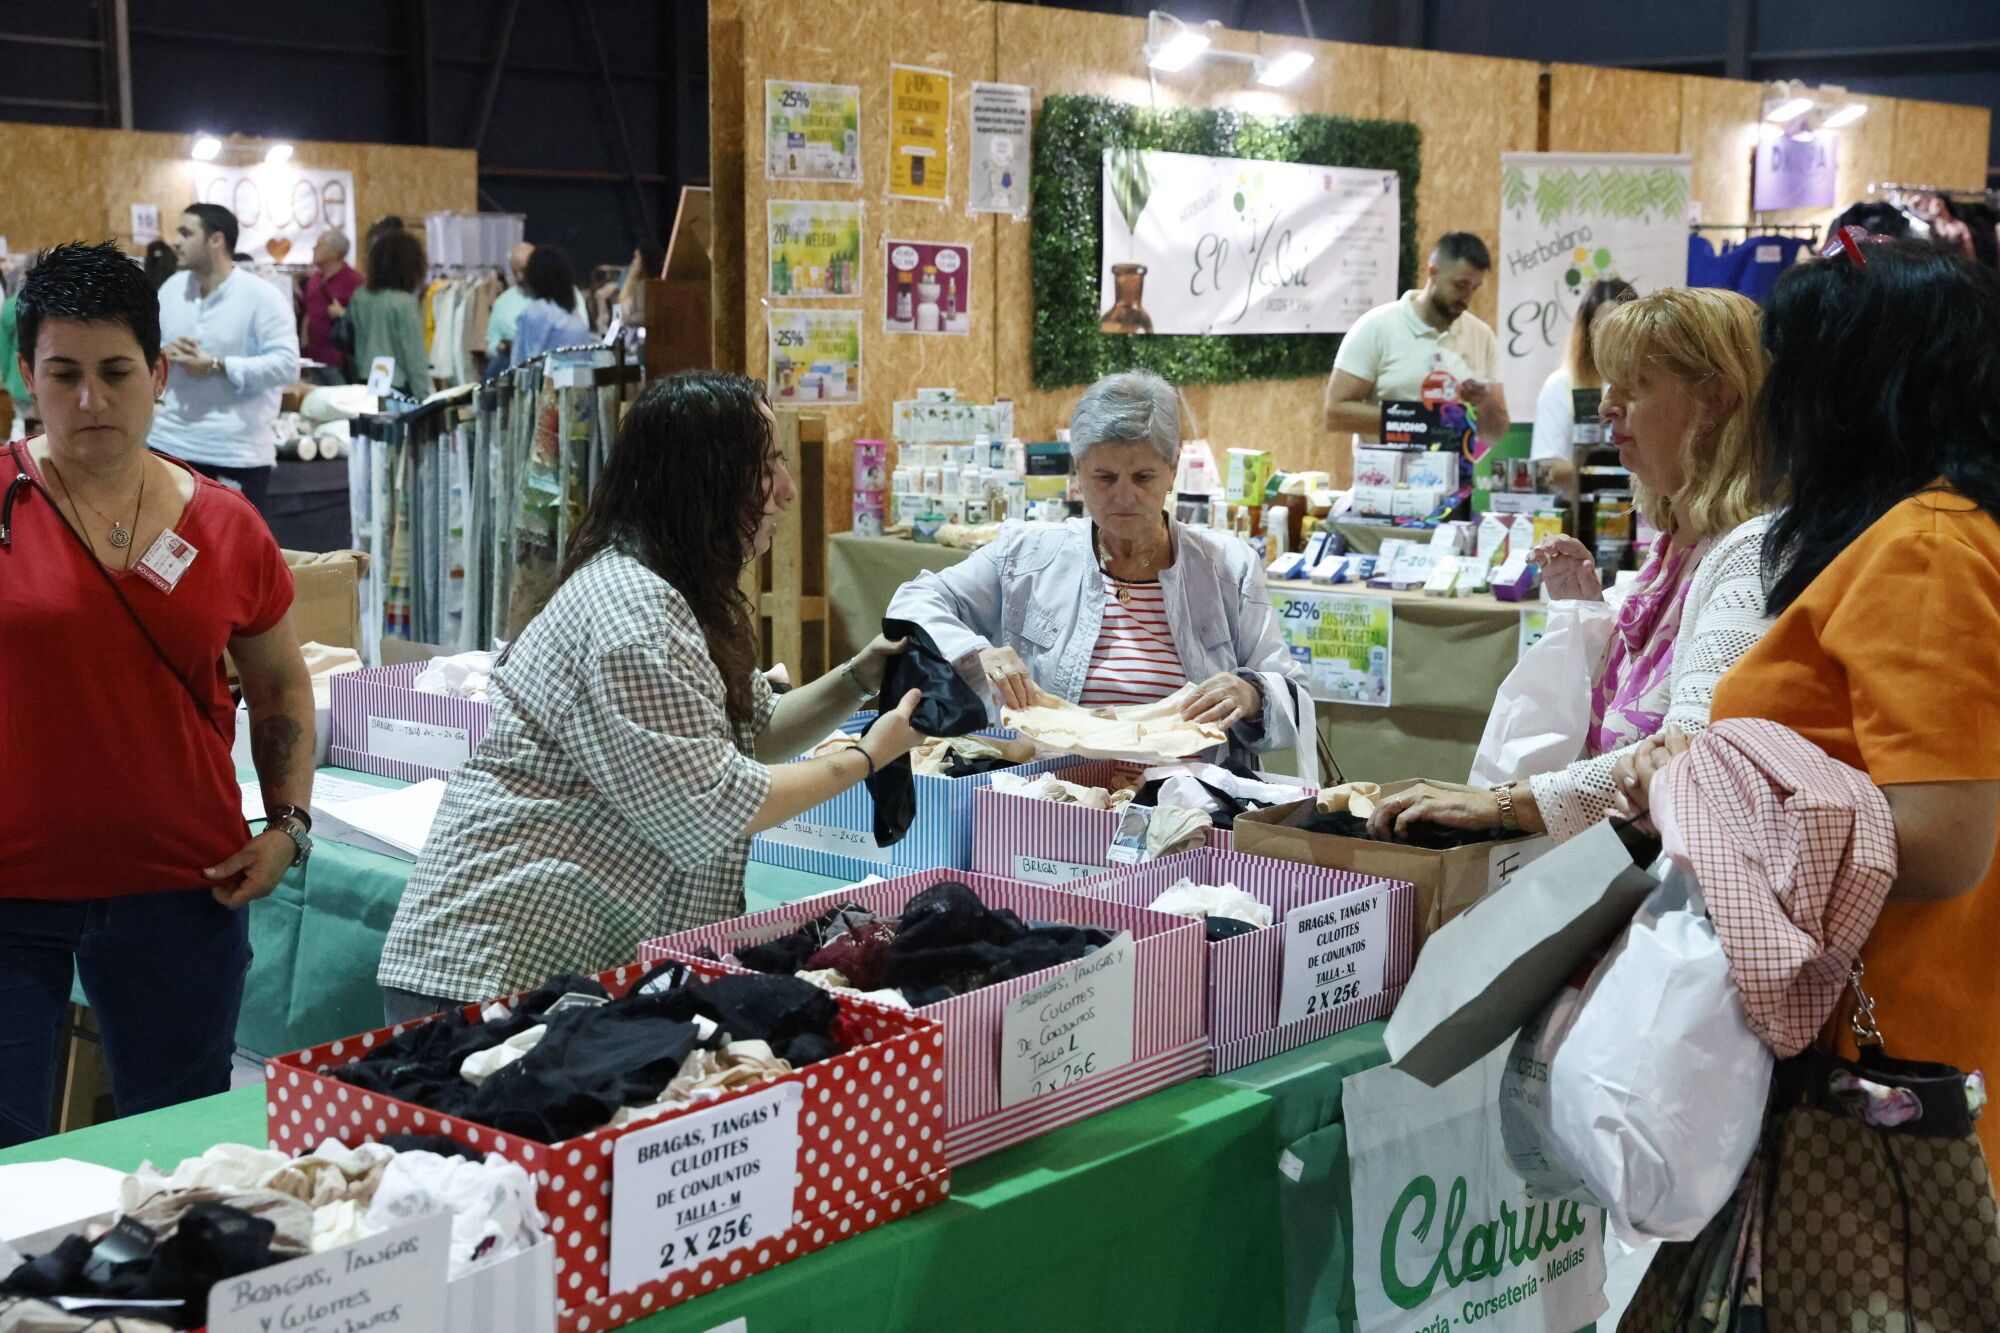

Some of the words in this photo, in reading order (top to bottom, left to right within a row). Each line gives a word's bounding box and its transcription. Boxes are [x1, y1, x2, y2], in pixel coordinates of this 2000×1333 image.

[778, 90, 810, 108] -25%
[1190, 232, 1230, 296] El
[1506, 225, 1593, 277] Herbolario
[1507, 300, 1559, 358] El
[1386, 421, 1428, 433] MUCHO
[1279, 600, 1320, 620] -25%
[1022, 857, 1058, 875] BRAGAS
[1298, 910, 1338, 935] BRAGAS,
[1340, 900, 1370, 922] TANGAS
[1372, 896, 1379, 911] Y
[1316, 922, 1361, 947] CULOTTES
[1308, 956, 1320, 969] DE
[1321, 939, 1367, 966] CONJUNTOS
[1315, 967, 1341, 985] TALLA
[1346, 961, 1357, 975] XL
[1306, 995, 1317, 1016] 2
[1333, 980, 1362, 1006] 25€
[1068, 1033, 1080, 1052] L
[636, 1130, 706, 1165] BRAGAS,
[711, 1106, 769, 1140] TANGAS
[772, 1100, 783, 1118] Y
[670, 1137, 750, 1178] CULOTTES
[656, 1188, 677, 1209] DE
[680, 1159, 762, 1199] CONJUNTOS
[676, 1198, 718, 1226] TALLA
[730, 1190, 743, 1206] M
[658, 1242, 675, 1269] 2
[706, 1212, 754, 1252] 25€
[1462, 1275, 1539, 1325] Corsetería
[1546, 1247, 1586, 1284] Medias
